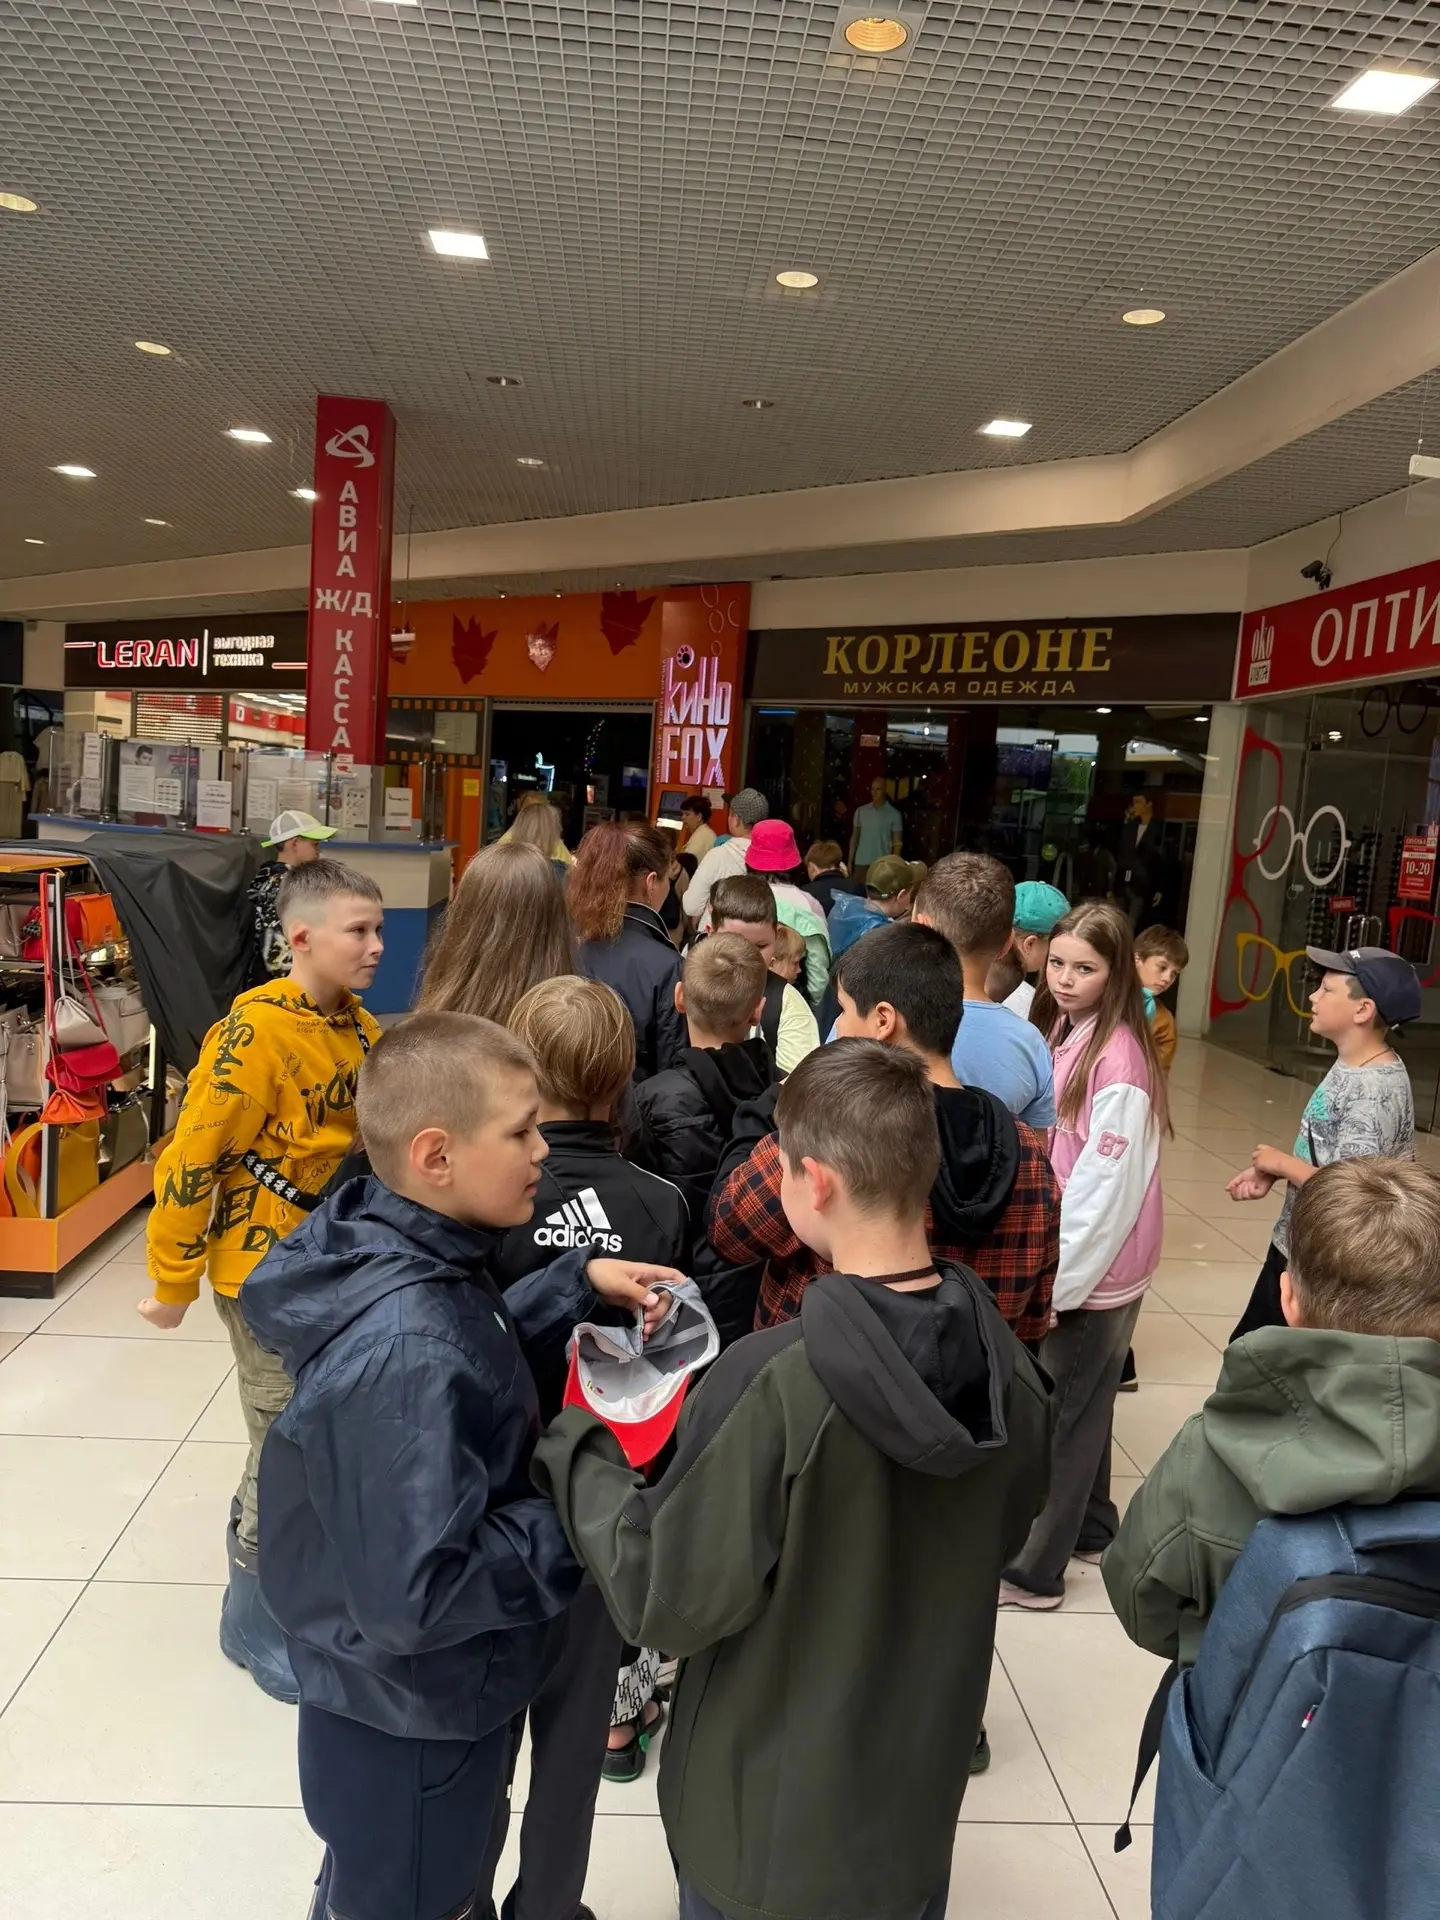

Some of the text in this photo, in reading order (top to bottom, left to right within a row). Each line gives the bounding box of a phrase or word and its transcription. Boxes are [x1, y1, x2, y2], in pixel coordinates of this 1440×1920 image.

[337, 480, 359, 578] АВИА
[315, 587, 372, 618] Ж/Д
[1310, 586, 1440, 667] ОПТИ
[97, 638, 199, 668] LERAN
[213, 635, 275, 652] выгодная
[823, 627, 1113, 675] КОРЛЕОНЕ
[213, 653, 264, 667] техника
[331, 629, 354, 748] КАССА
[843, 680, 1076, 696] МУЖСКАЯ ОДЕЖДА
[660, 726, 728, 786] FOX
[1405, 860, 1431, 876] 10-20
[1096, 1130, 1130, 1161] 87
[533, 1224, 623, 1252] adidas
